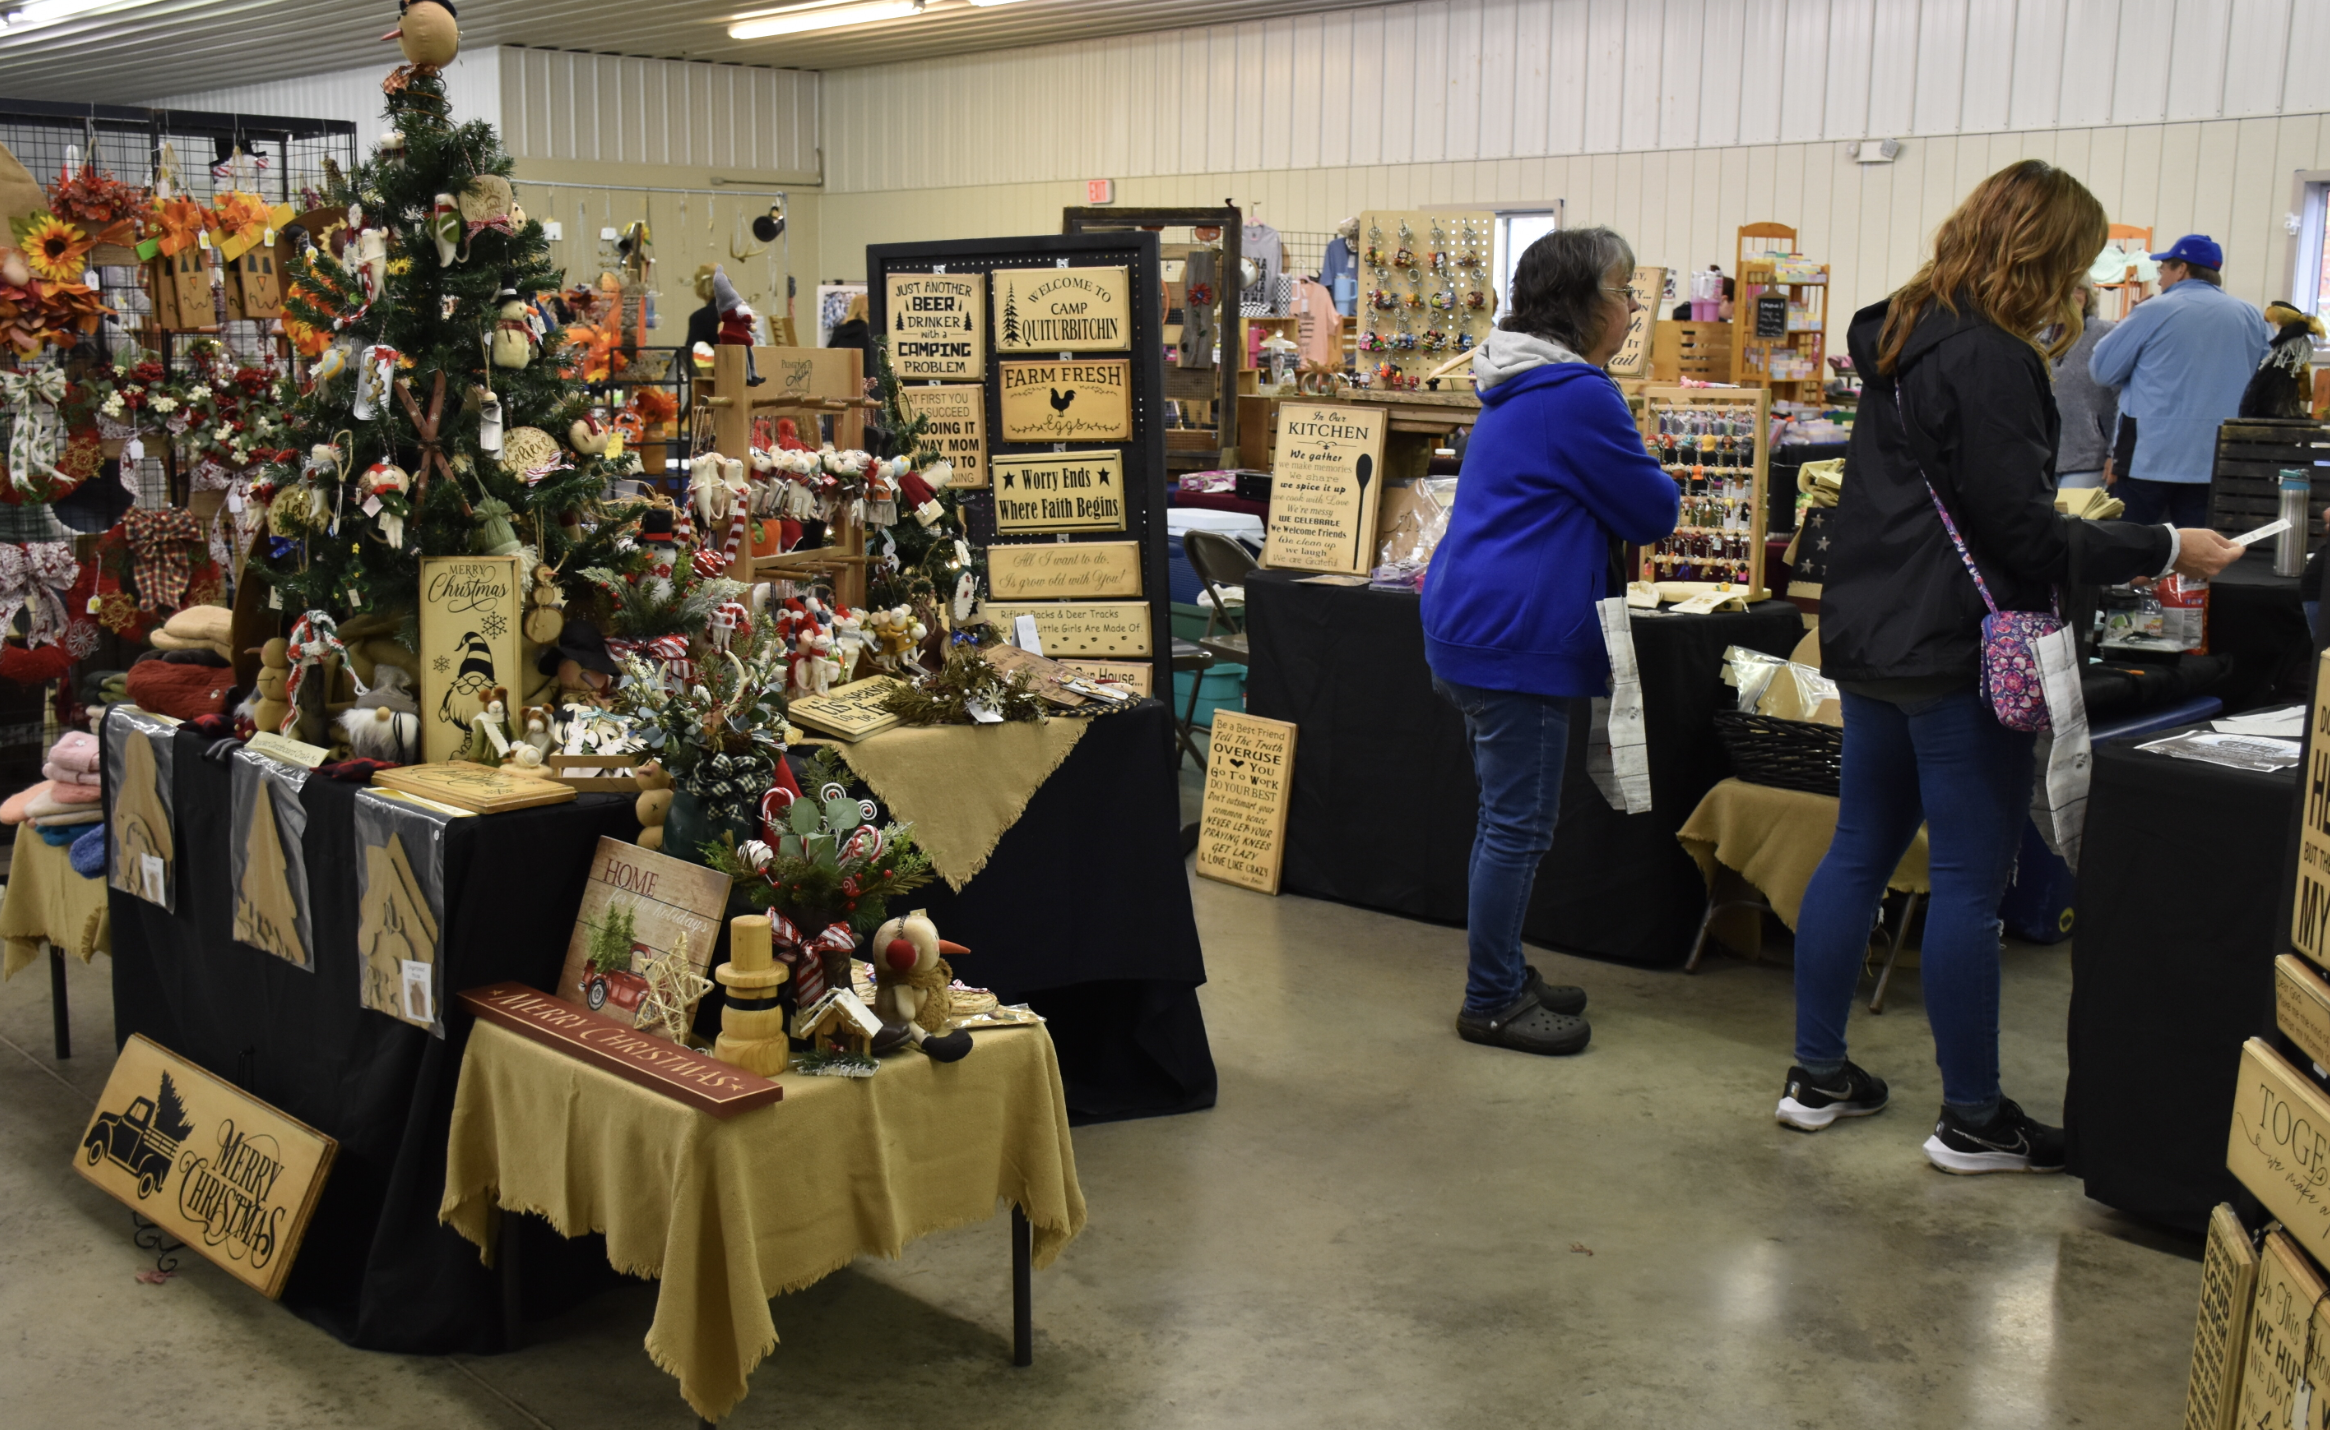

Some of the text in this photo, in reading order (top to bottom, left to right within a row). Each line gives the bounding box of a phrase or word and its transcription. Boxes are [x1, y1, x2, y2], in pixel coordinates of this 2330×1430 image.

[896, 282, 972, 297] JUST ANOTHER
[1028, 277, 1111, 303] WELCOME TO
[913, 297, 954, 311] BEER
[1051, 302, 1087, 315] CAMP
[908, 317, 960, 328] DRINKER
[921, 330, 939, 338] with
[1023, 318, 1118, 347] QUITURBITCHIN
[898, 342, 971, 357] CAMPING
[904, 361, 966, 373] PROBLEM
[1005, 366, 1121, 389] FARM FRESH
[921, 394, 946, 404] FIRST
[949, 393, 968, 403] YOU
[926, 407, 970, 417] SUCCEED
[1313, 411, 1346, 422] In Our
[965, 422, 975, 434] IT
[1043, 414, 1087, 436] Eggs
[1288, 422, 1369, 440] KITCHEN
[503, 436, 551, 471] Believe
[949, 439, 979, 451] MOM
[961, 456, 976, 468] TO
[1290, 449, 1343, 462] We gather
[1289, 471, 1339, 483] We share
[1292, 462, 1313, 470] make
[1314, 463, 1352, 474] memories
[1022, 467, 1091, 491] Worry Ends
[1286, 493, 1303, 502] cook
[1306, 494, 1323, 504] with
[1325, 495, 1349, 506] Love
[1334, 487, 1346, 495] up
[999, 496, 1118, 520] Where Faith Begins
[1287, 503, 1333, 518] We're messy
[1271, 524, 1347, 539] We Welcome Friends
[1294, 517, 1340, 527] CELEBRATE
[1296, 538, 1322, 547] clean
[1324, 542, 1336, 551] up
[1302, 548, 1327, 558] laugh
[1013, 552, 1037, 568] All
[1039, 551, 1054, 567] I
[1054, 554, 1079, 565] want
[1081, 553, 1090, 564] to
[1305, 557, 1338, 567] Grateful
[449, 564, 496, 578] MERRY
[1000, 569, 1126, 594] Is grow old with You!
[428, 573, 510, 613] Christmas
[1058, 610, 1063, 619] &
[1066, 610, 1087, 619] Deer
[1090, 609, 1119, 619] Tracks
[1062, 624, 1082, 633] Girls
[1085, 625, 1100, 633] Are
[1103, 623, 1126, 633] Made
[1217, 719, 1285, 740] Be a Best Friend
[1215, 731, 1283, 752] Tell The Truth
[1214, 743, 1281, 765] OVERUSE
[1217, 756, 1274, 776] I YOU
[1211, 779, 1277, 801] DO YOUR BEST
[1208, 791, 1275, 815] Don't outsmart your
[1213, 806, 1243, 819] common
[1205, 816, 1231, 828] NEVER
[1251, 826, 1273, 839] YOUR
[1204, 827, 1272, 851] PRAYING KNEES
[1212, 843, 1259, 860] GET LAZY
[2303, 841, 2319, 867] BUT
[1208, 854, 1226, 866] LOVE
[1228, 858, 1244, 871] LIKE
[1246, 864, 1268, 877] CRAZY
[603, 859, 659, 898] HOME
[654, 897, 709, 938] holidays
[499, 993, 739, 1089] MERRY CHRISTMAS
[2260, 1083, 2330, 1174] TOGE
[211, 1118, 285, 1202] MERRY
[2267, 1155, 2285, 1171] we
[2285, 1167, 2328, 1205] make
[179, 1150, 287, 1270] CHRISTMAS
[2204, 1258, 2230, 1320] LOUD
[2258, 1259, 2299, 1346] In This
[2200, 1281, 2228, 1349] LAUGH
[2255, 1308, 2273, 1356] WE
[2250, 1346, 2282, 1407] WE DO
